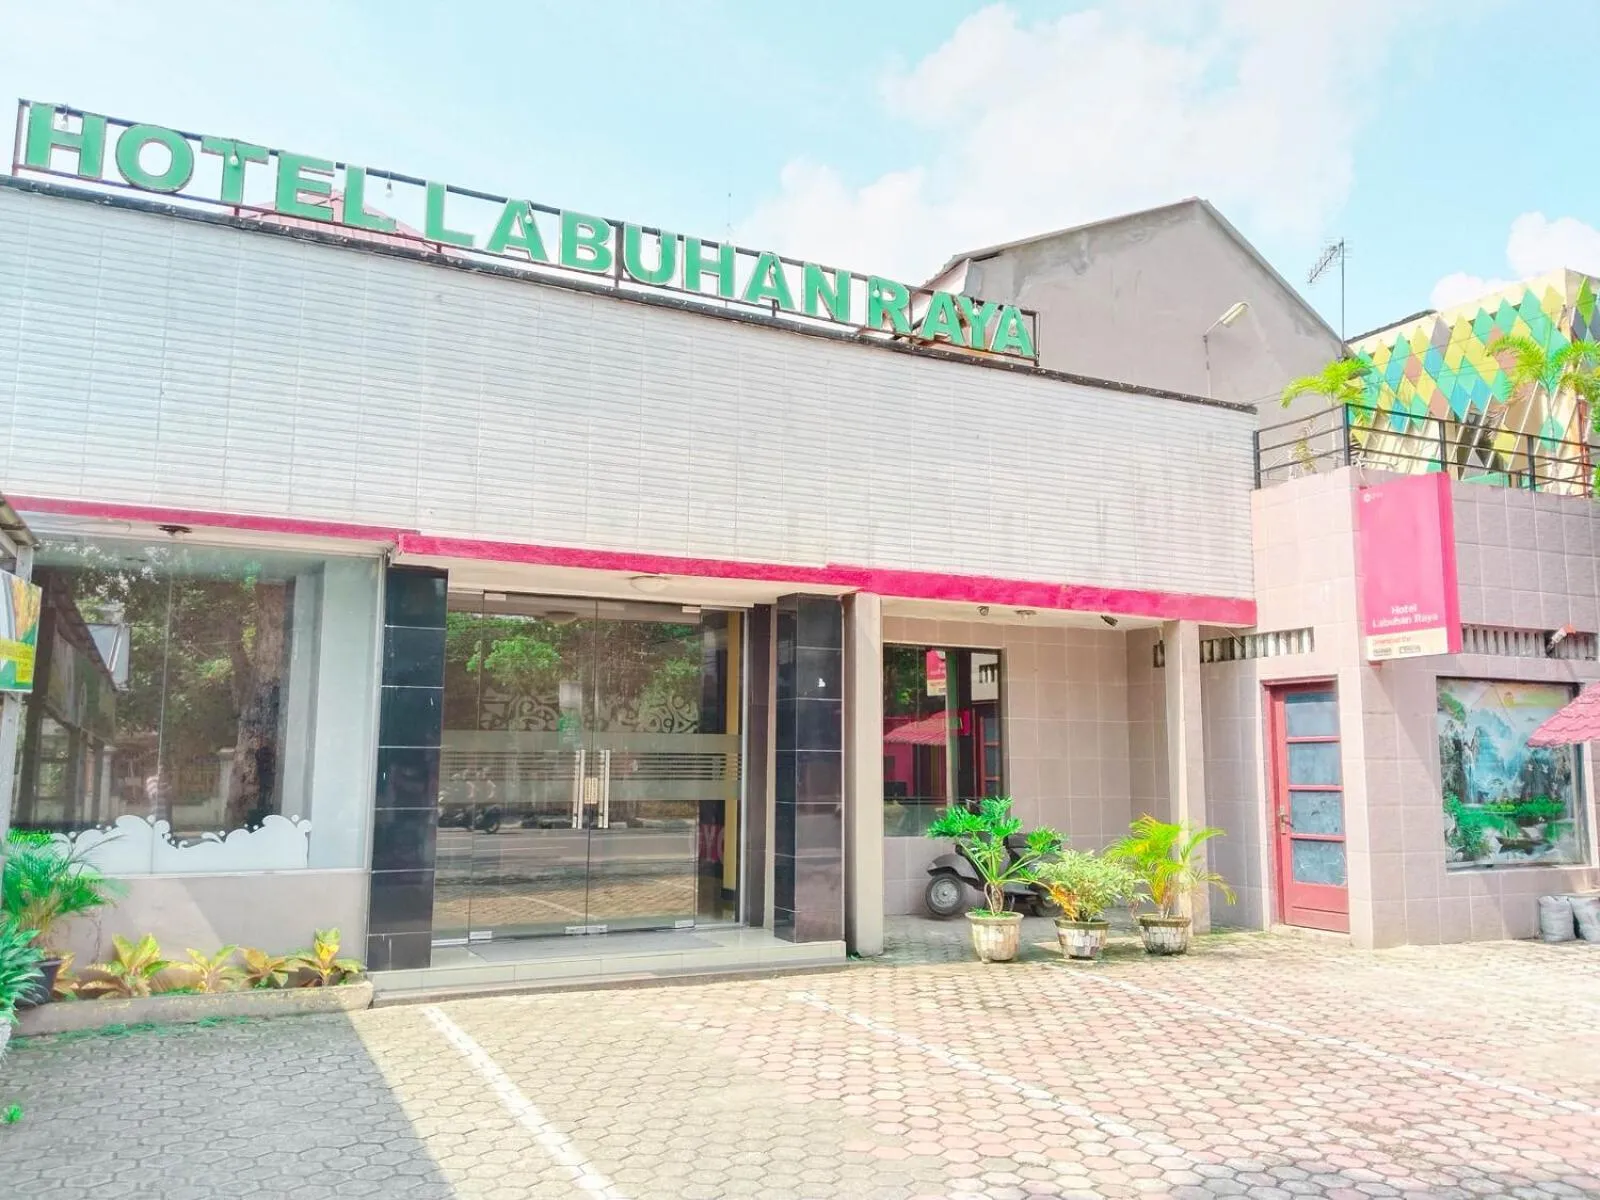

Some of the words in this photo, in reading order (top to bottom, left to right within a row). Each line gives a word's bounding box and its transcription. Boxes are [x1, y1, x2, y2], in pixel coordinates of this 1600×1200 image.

[24, 101, 397, 232] HOTEL
[425, 180, 852, 323] LABUHAN
[867, 275, 1036, 358] RAYA
[1391, 603, 1417, 615] Hotel
[1414, 613, 1439, 625] Raya
